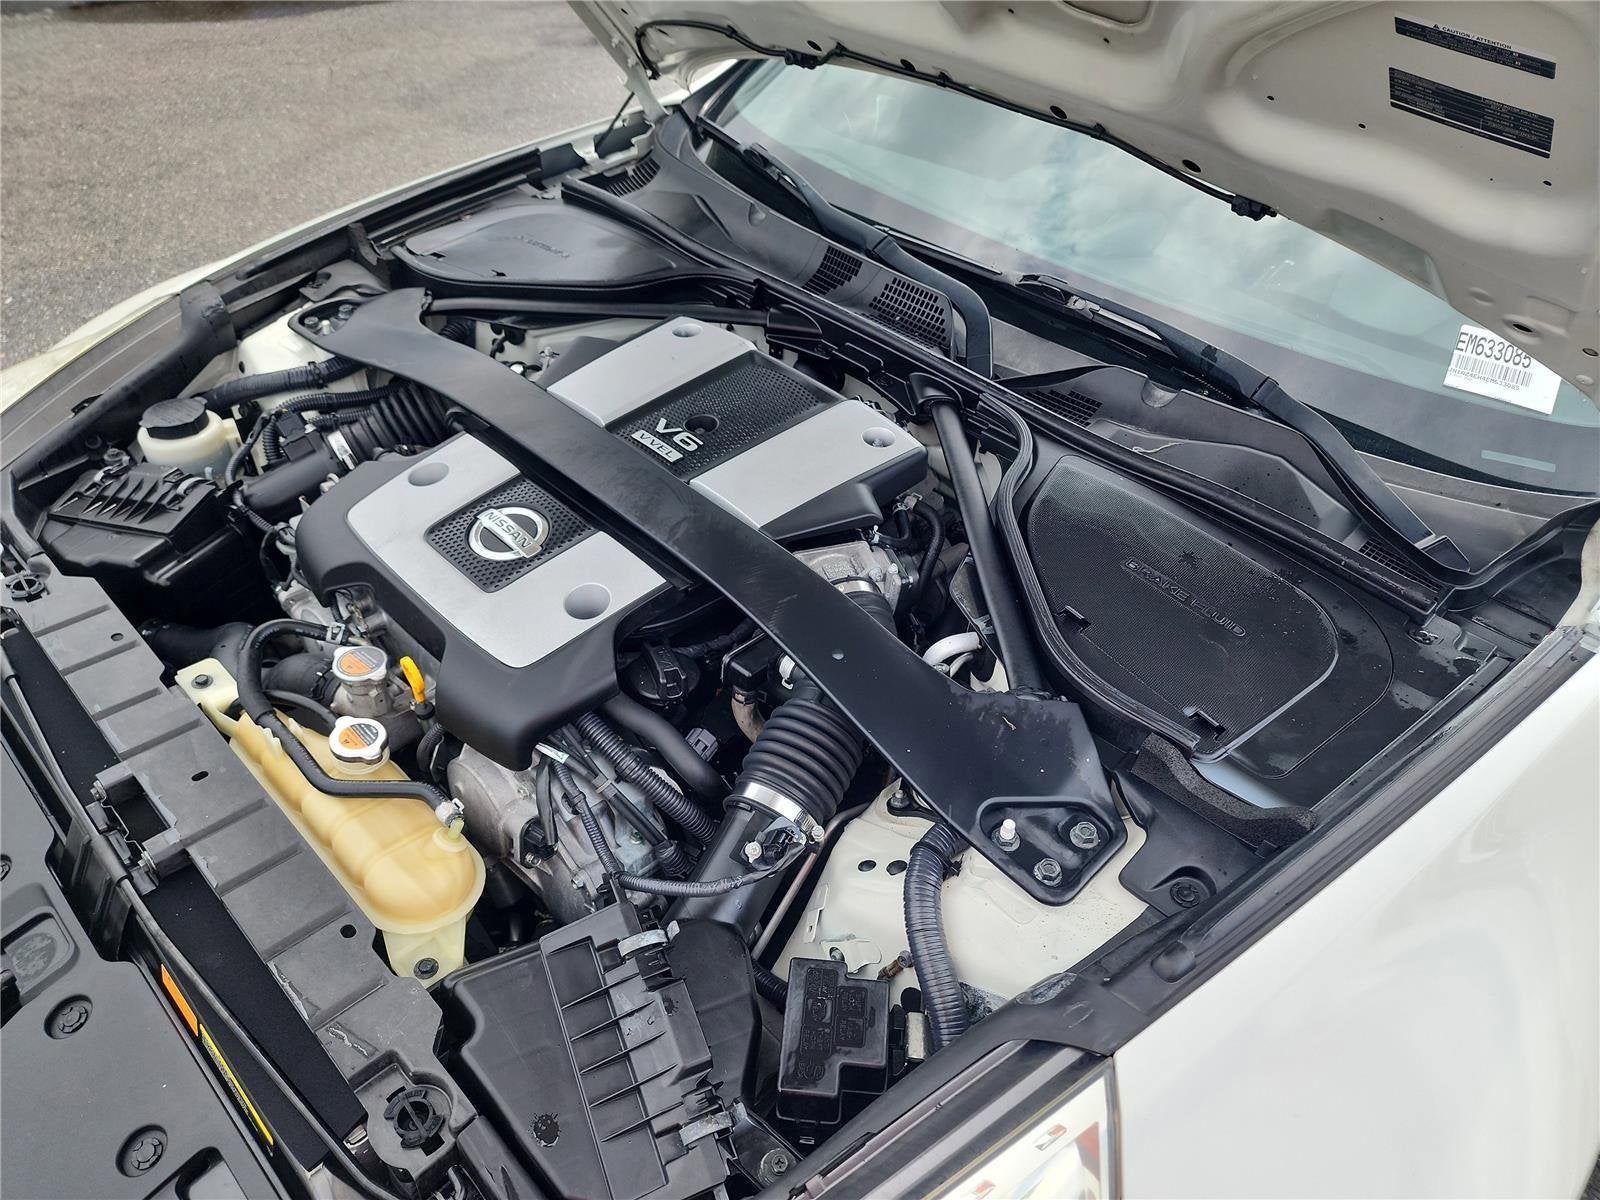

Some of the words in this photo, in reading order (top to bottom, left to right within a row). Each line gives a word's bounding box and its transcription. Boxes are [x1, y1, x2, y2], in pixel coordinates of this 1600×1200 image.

[1442, 26, 1471, 38] CAUTION
[1476, 36, 1512, 50] ATTENTION
[1455, 332, 1532, 369] EM633085
[639, 432, 674, 459] VVEL
[655, 417, 704, 452] V6
[484, 511, 532, 549] NISSAN
[1125, 557, 1191, 602] BRAKE
[1190, 598, 1247, 637] FLUID
